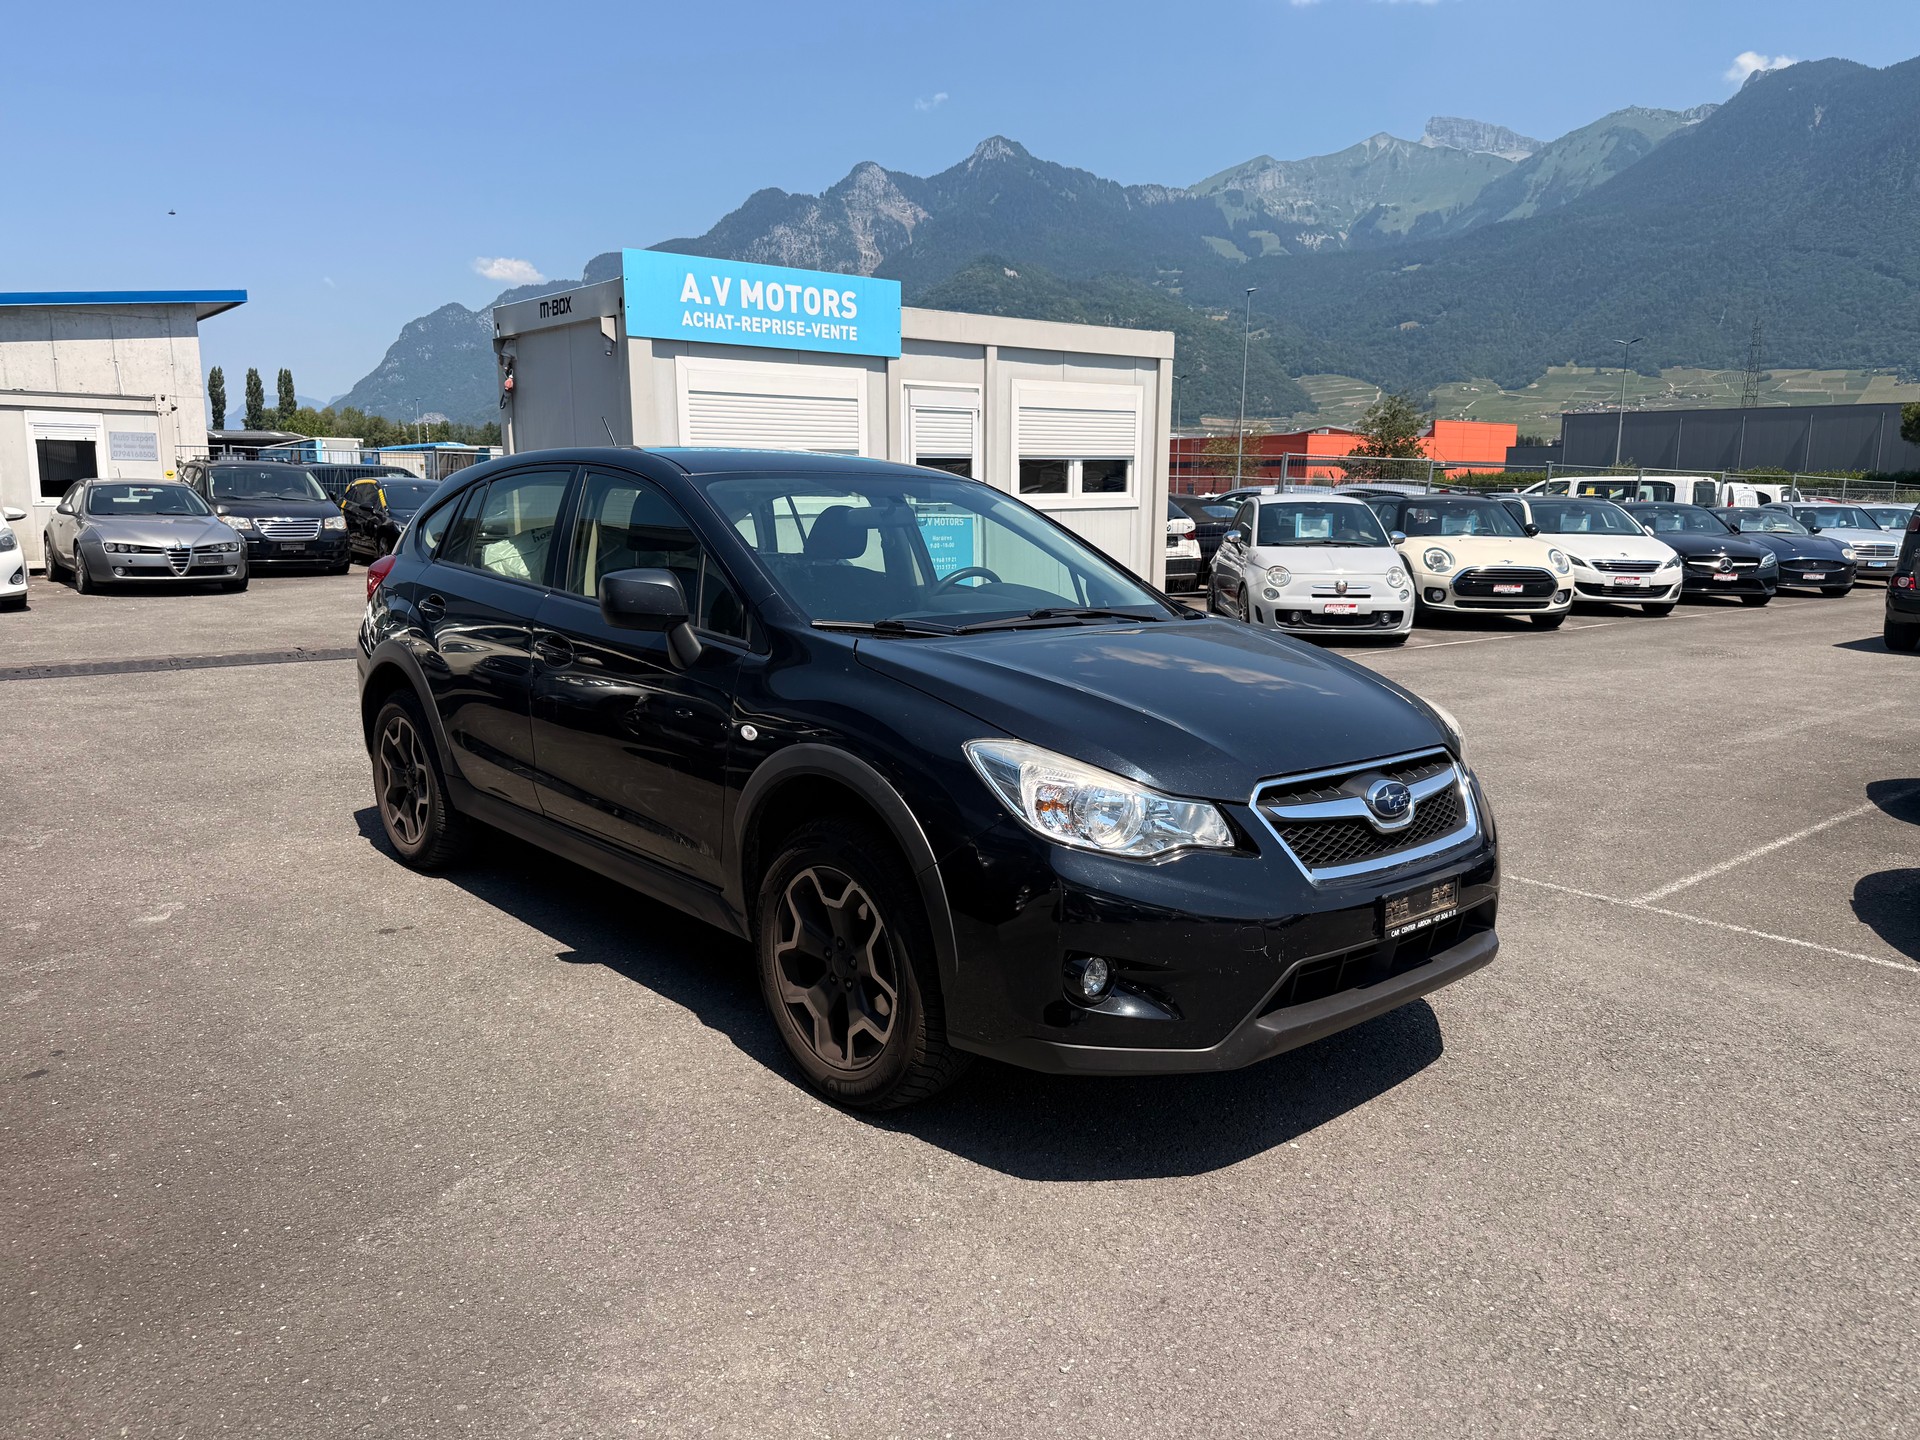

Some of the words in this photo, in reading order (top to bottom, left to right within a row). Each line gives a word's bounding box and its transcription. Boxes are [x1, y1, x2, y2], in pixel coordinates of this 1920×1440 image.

[680, 272, 731, 306] A.V
[740, 278, 858, 319] MOTORS
[681, 310, 858, 341] ACHAT-REPRISE-VENTE
[113, 434, 130, 442] Auto
[131, 434, 154, 443] Export
[933, 518, 964, 526] MOTORS
[1391, 929, 1400, 937] CAR
[1401, 923, 1416, 934] CENTER
